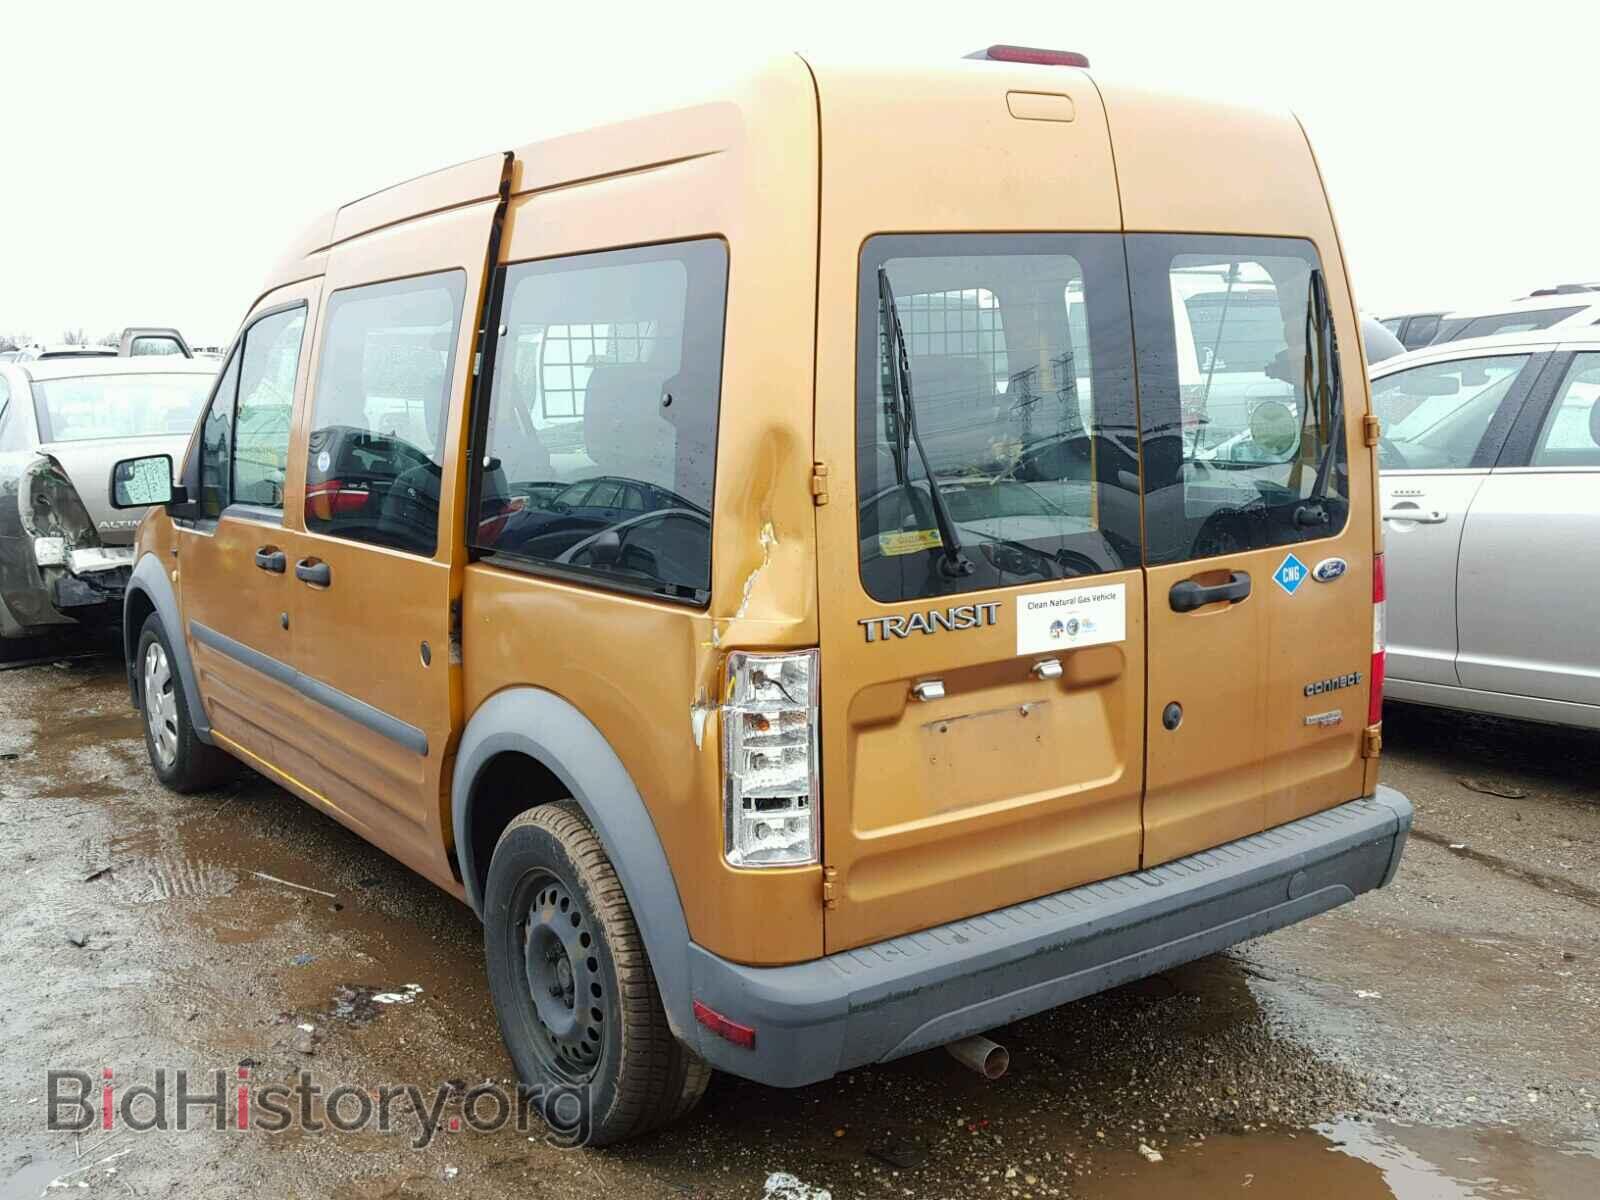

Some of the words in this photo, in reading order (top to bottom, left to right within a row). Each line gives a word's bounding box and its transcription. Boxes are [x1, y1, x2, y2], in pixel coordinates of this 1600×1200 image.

[1282, 566, 1300, 582] CNG
[1317, 559, 1346, 580] Ford
[1027, 601, 1048, 610] Clean
[1049, 597, 1076, 608] Natural
[1077, 595, 1091, 604] Gas
[1092, 592, 1117, 602] Vehicle
[858, 601, 1002, 642] TRANSIT
